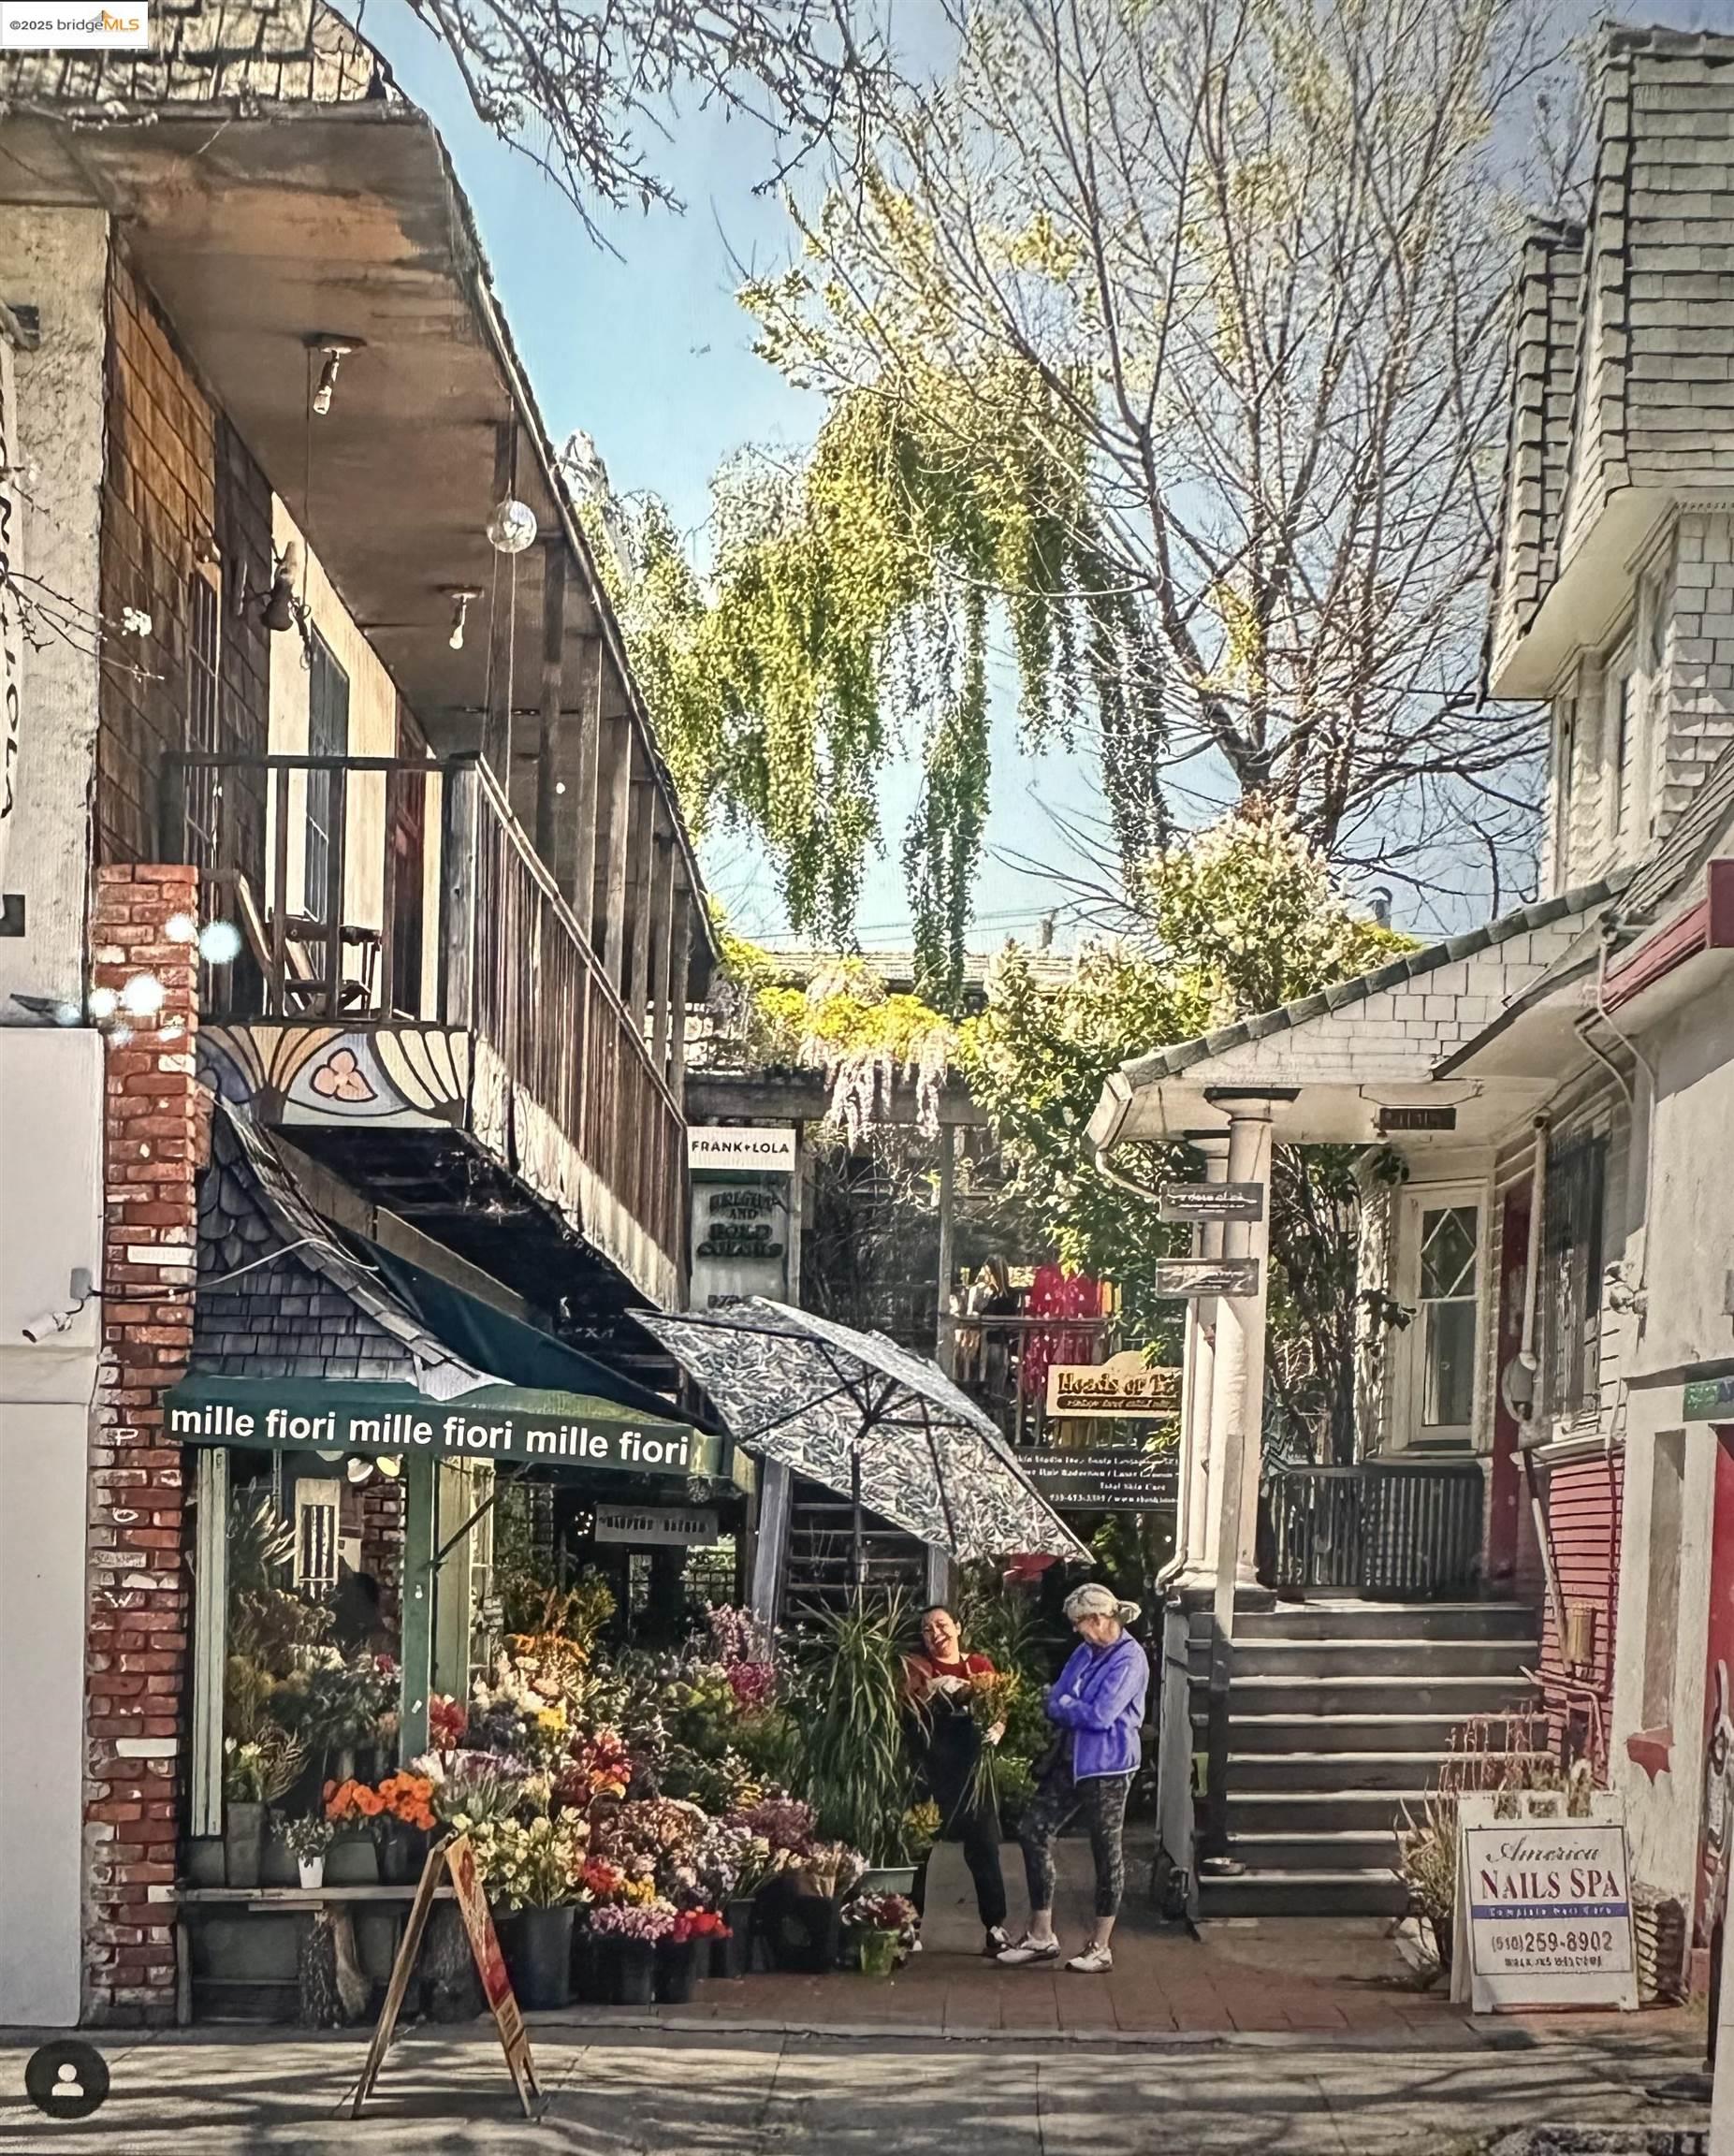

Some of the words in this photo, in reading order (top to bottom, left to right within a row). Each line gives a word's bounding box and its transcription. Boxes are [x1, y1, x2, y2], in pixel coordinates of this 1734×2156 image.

[691, 1140, 790, 1154] FRANK+LOLA
[171, 1405, 254, 1437] mille
[266, 1408, 336, 1441] fiori
[349, 1413, 433, 1445] mille
[443, 1417, 513, 1450] fiori
[526, 1424, 608, 1458] mille
[619, 1432, 689, 1465] fiori
[1485, 1834, 1600, 1863] America
[1479, 1869, 1561, 1900] NAILS
[1570, 1868, 1621, 1899] SPA
